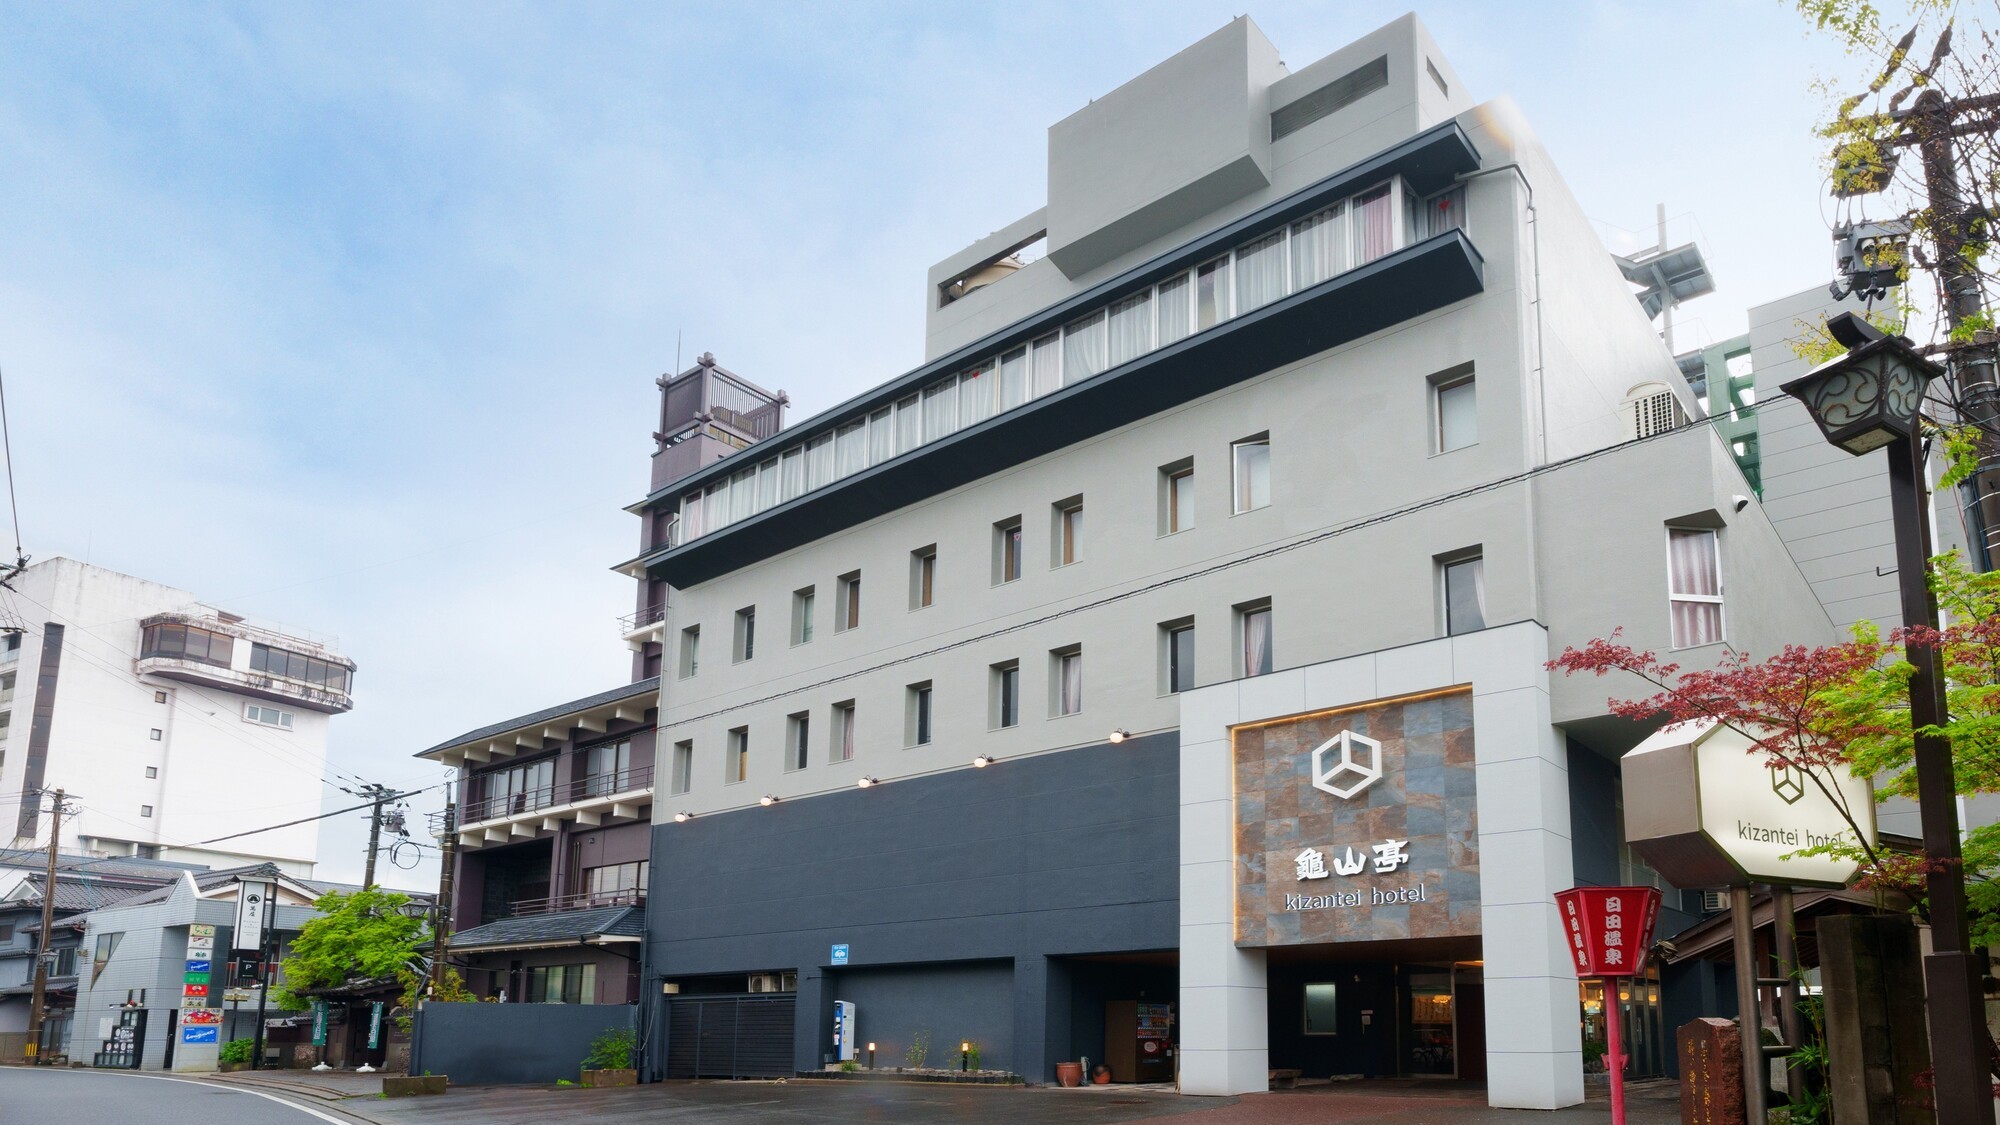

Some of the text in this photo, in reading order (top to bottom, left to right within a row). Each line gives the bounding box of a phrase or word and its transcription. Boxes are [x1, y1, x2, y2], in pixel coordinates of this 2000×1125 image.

[1738, 820, 1842, 851] kizantei hotel
[1285, 883, 1426, 911] kizantei hotel
[1604, 896, 1623, 965] 日田温泉
